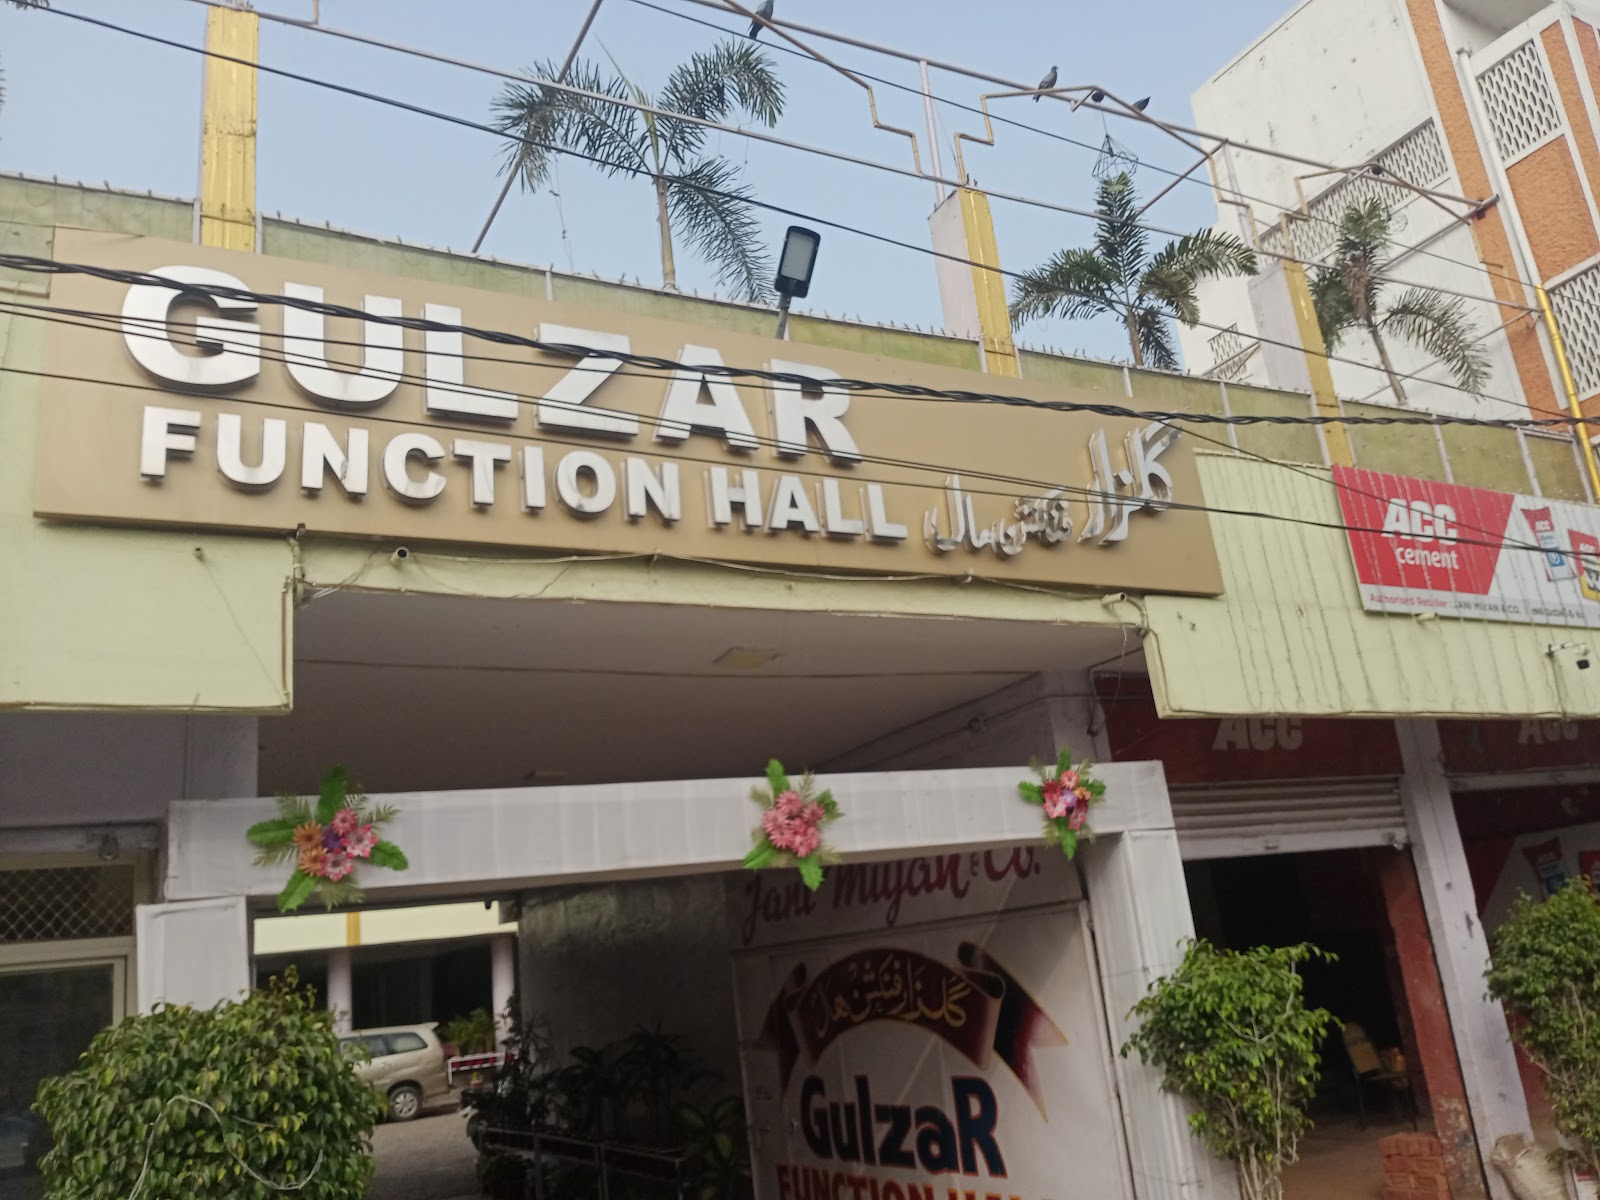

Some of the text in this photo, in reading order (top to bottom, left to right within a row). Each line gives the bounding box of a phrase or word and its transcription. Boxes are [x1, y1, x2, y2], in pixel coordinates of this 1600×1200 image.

[120, 265, 862, 466] GULZAR
[138, 405, 908, 542] FUNCTION HALL
[1381, 498, 1459, 545] ACC
[1395, 547, 1459, 570] cement
[801, 1075, 1008, 1179] GulzaR
